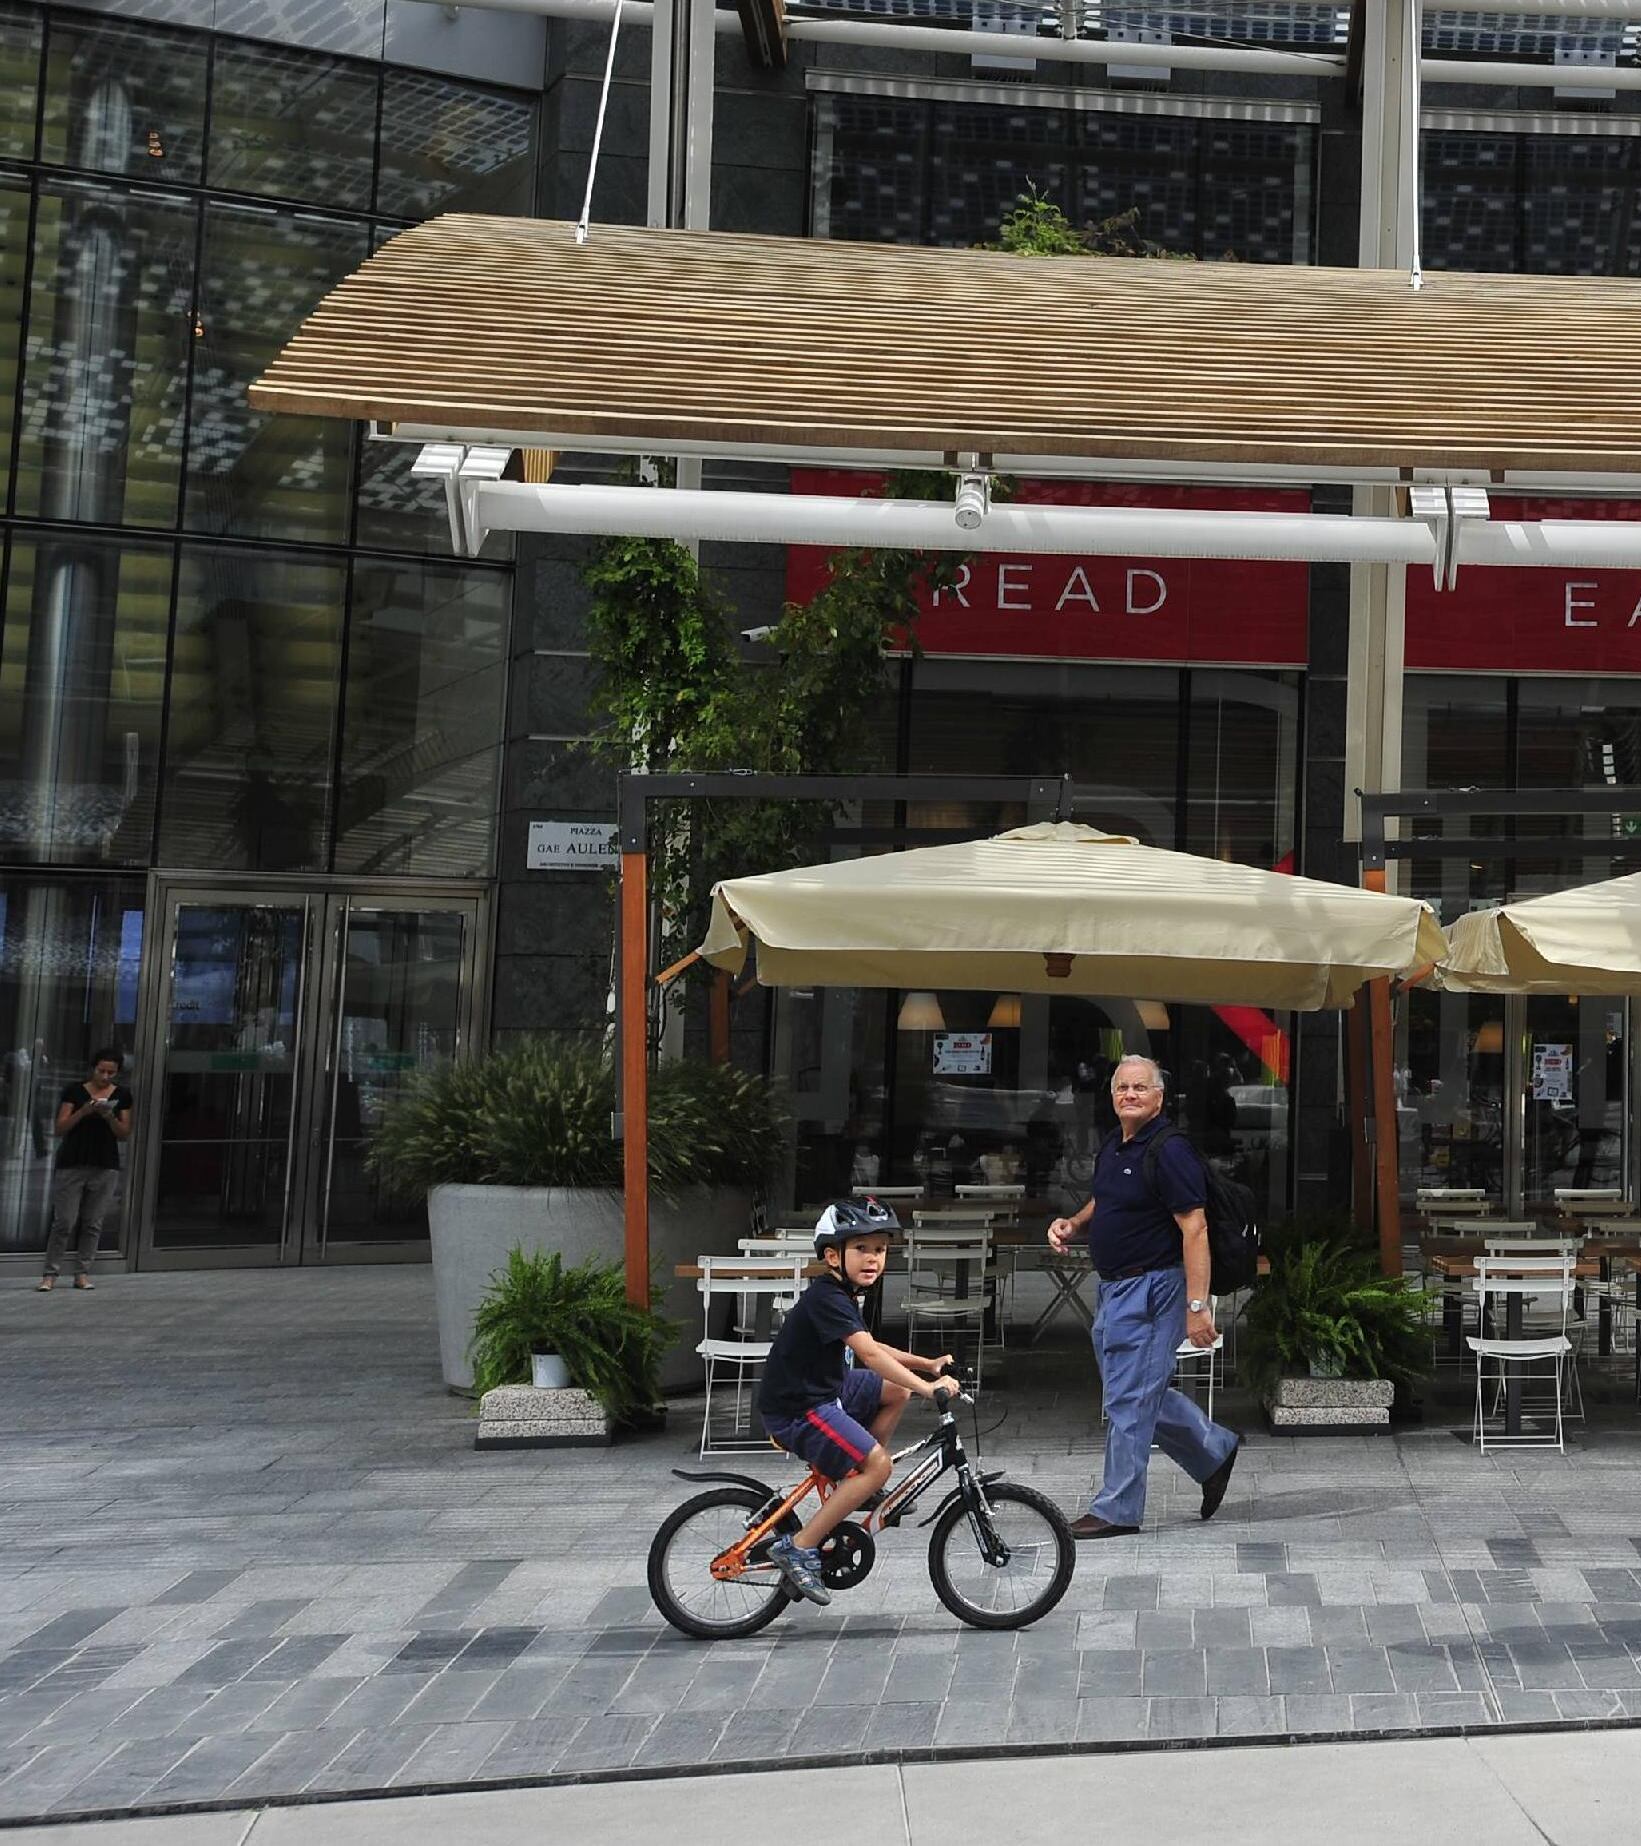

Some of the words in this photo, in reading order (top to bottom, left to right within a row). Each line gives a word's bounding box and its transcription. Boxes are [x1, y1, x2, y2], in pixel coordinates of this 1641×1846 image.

[932, 563, 1168, 614] READ
[570, 827, 602, 836] PIAZZA
[537, 844, 560, 853] GAE
